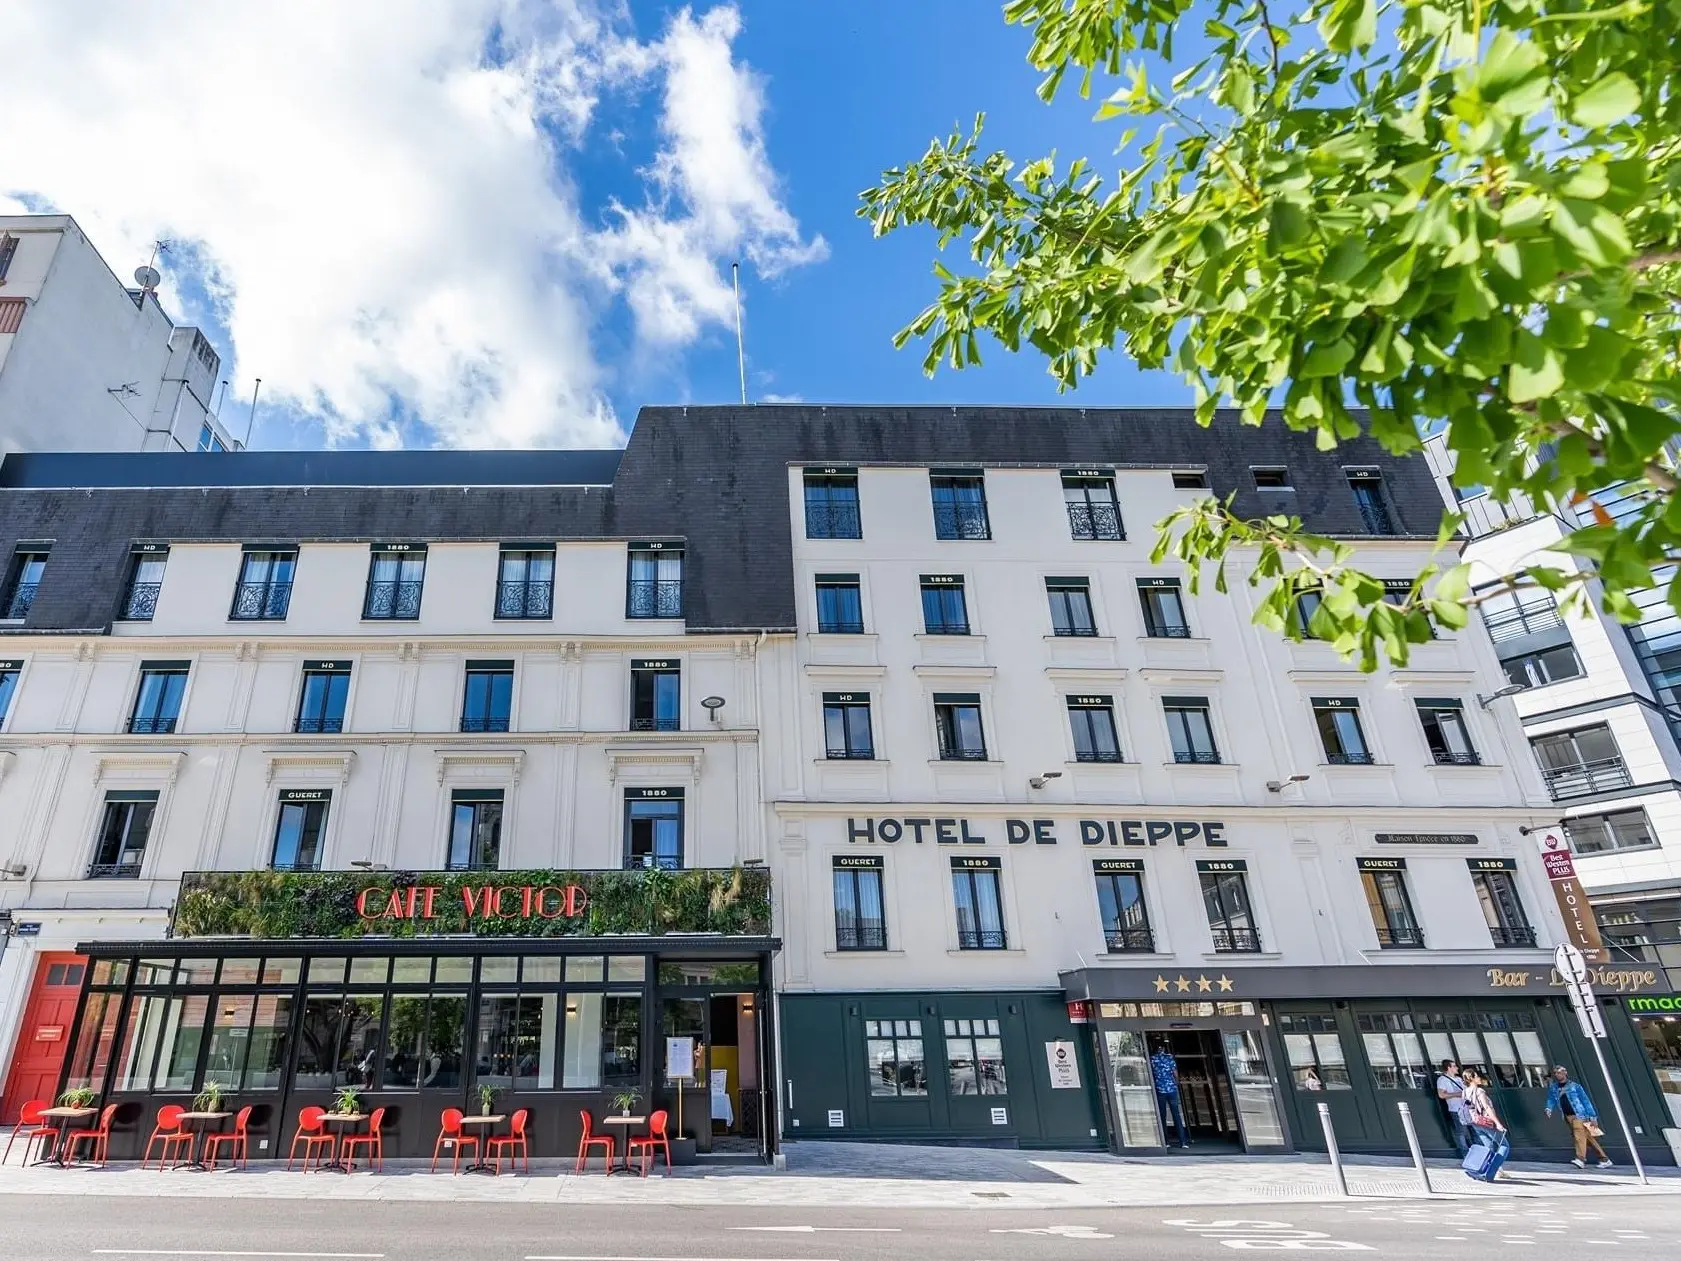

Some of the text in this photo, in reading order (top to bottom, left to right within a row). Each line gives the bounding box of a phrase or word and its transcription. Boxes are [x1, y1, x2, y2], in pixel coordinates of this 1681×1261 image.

[287, 791, 323, 799] GUERET
[847, 818, 1228, 847] HOTEL DE DIEPPE
[841, 858, 876, 866] GUERET
[1363, 860, 1399, 868] GUERET
[1553, 866, 1570, 874] PLUS
[355, 884, 588, 919] CAFE VICTOR
[1562, 882, 1588, 944] HOTEL
[1487, 968, 1529, 987] Bar
[1585, 966, 1657, 992] Dieppe
